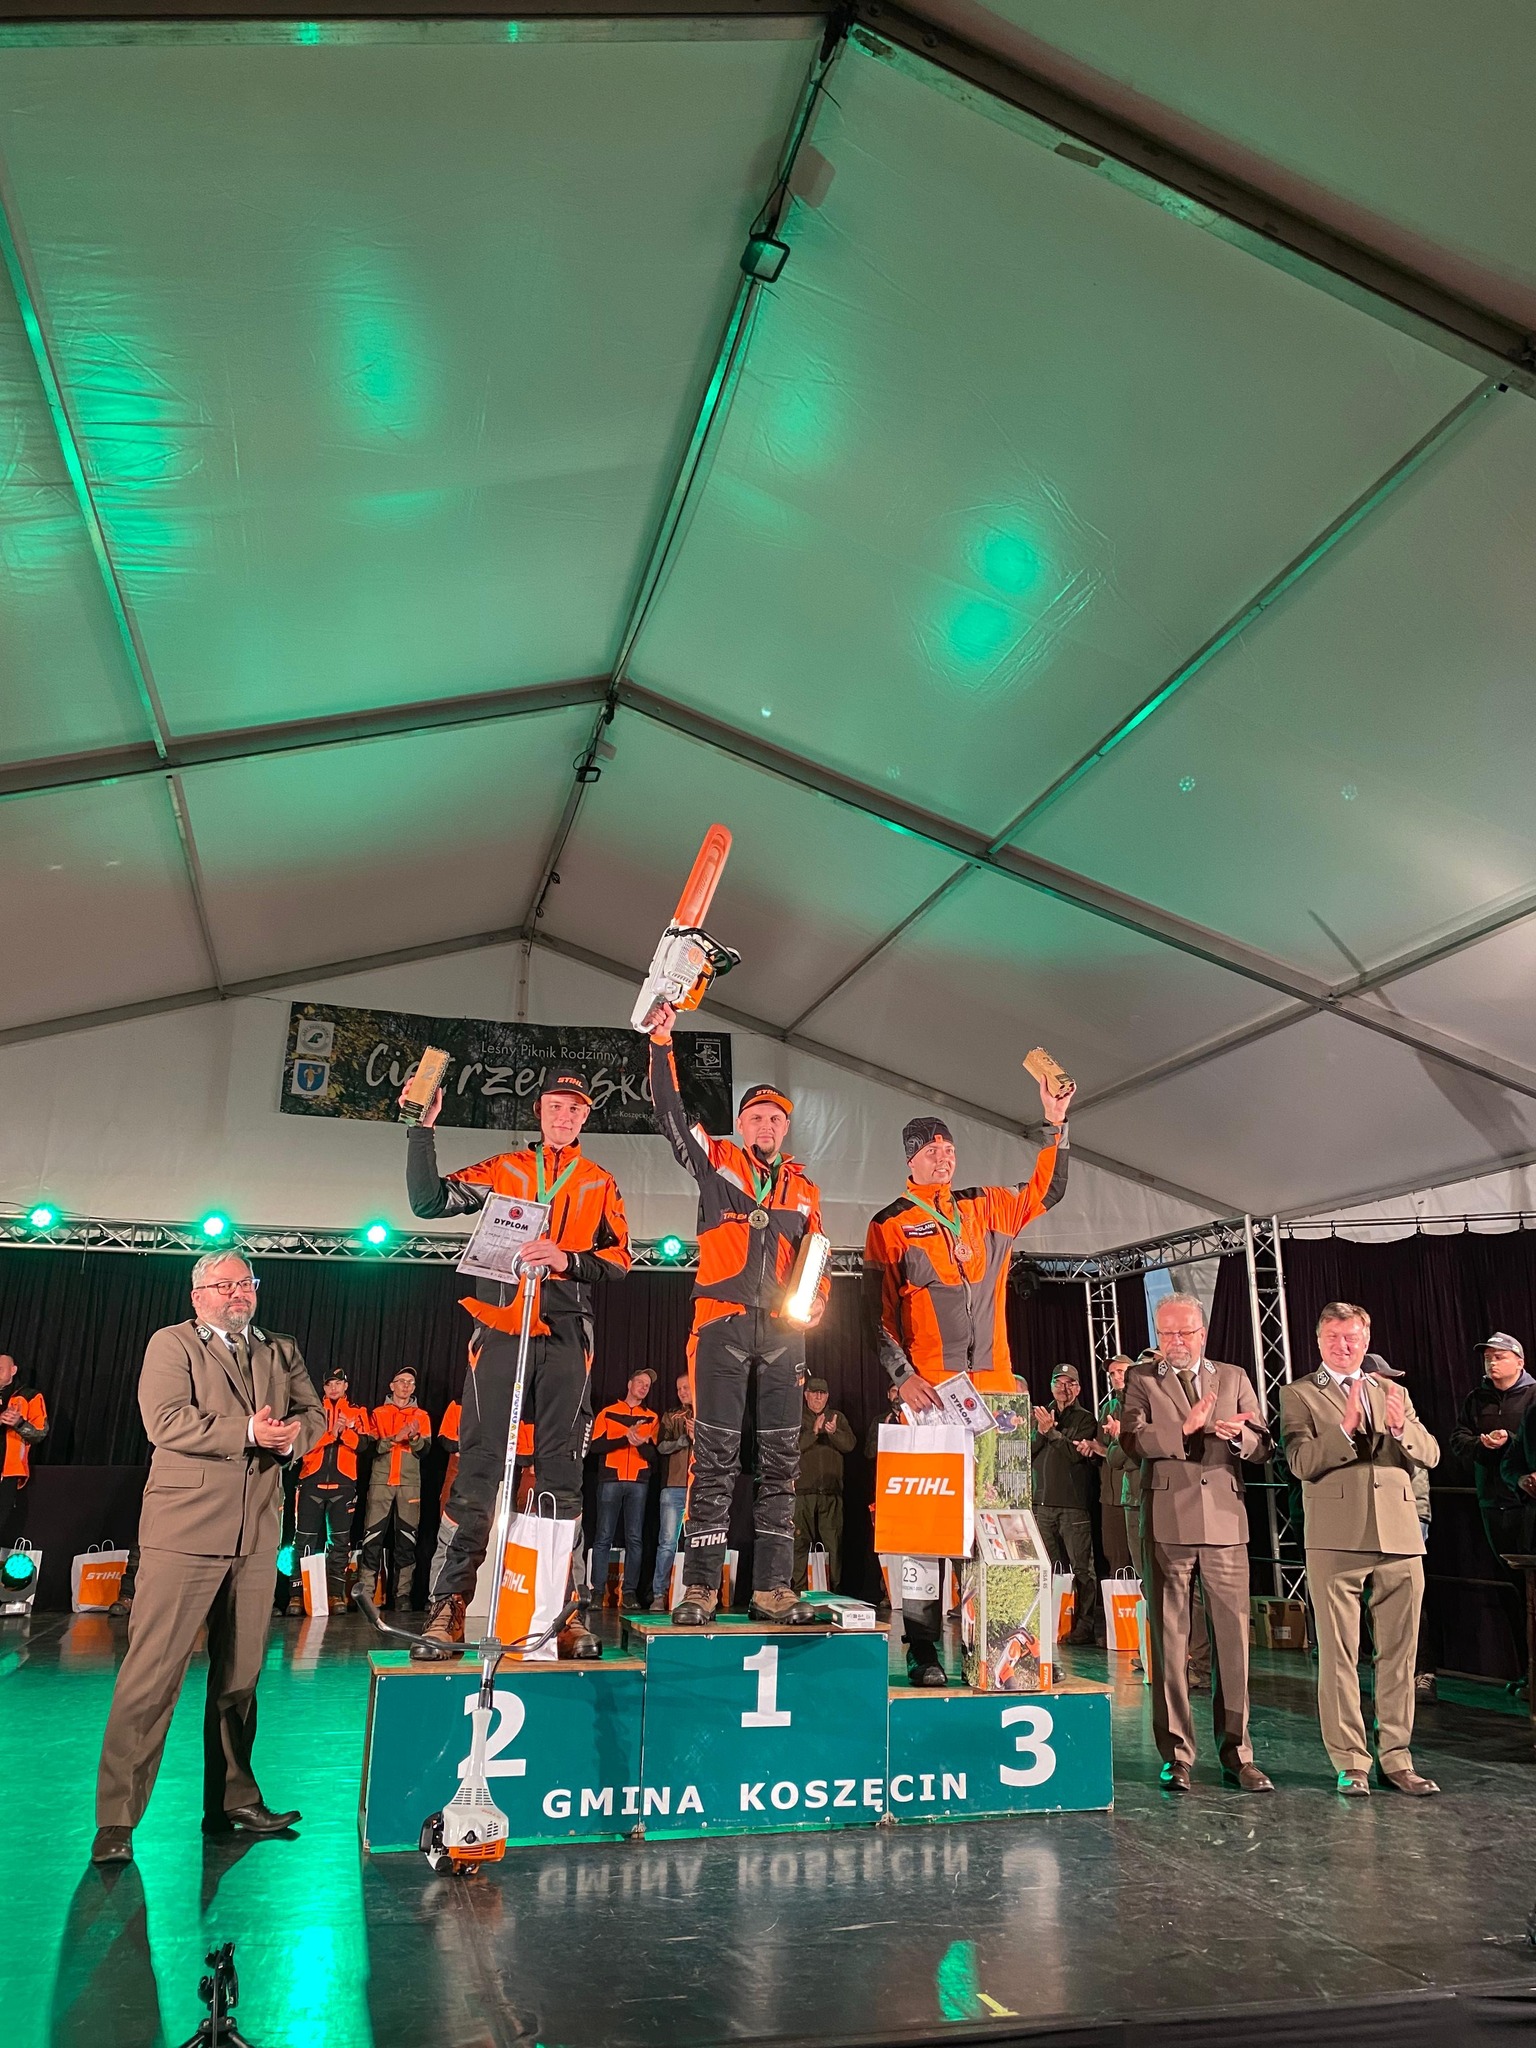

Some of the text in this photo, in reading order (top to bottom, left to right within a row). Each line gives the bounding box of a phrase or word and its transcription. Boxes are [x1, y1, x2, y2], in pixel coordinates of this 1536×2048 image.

[521, 1043, 556, 1059] Piknik
[561, 1046, 618, 1064] Rodzinny
[421, 1065, 436, 1081] 2
[494, 1217, 529, 1231] DYPLOM
[914, 1222, 936, 1232] POLAND
[950, 1393, 972, 1425] DYPLOM
[581, 1419, 593, 1459] STIHL
[884, 1476, 956, 1496] STIHL
[690, 1531, 728, 1548] STIHL
[85, 1571, 121, 1580] STIHL
[903, 1566, 918, 1583] 23
[741, 1645, 791, 1728] 1
[457, 1690, 527, 1779] 2
[1000, 1705, 1057, 1787] 3
[542, 1772, 968, 1819] GMINA KOSZĘCIN
